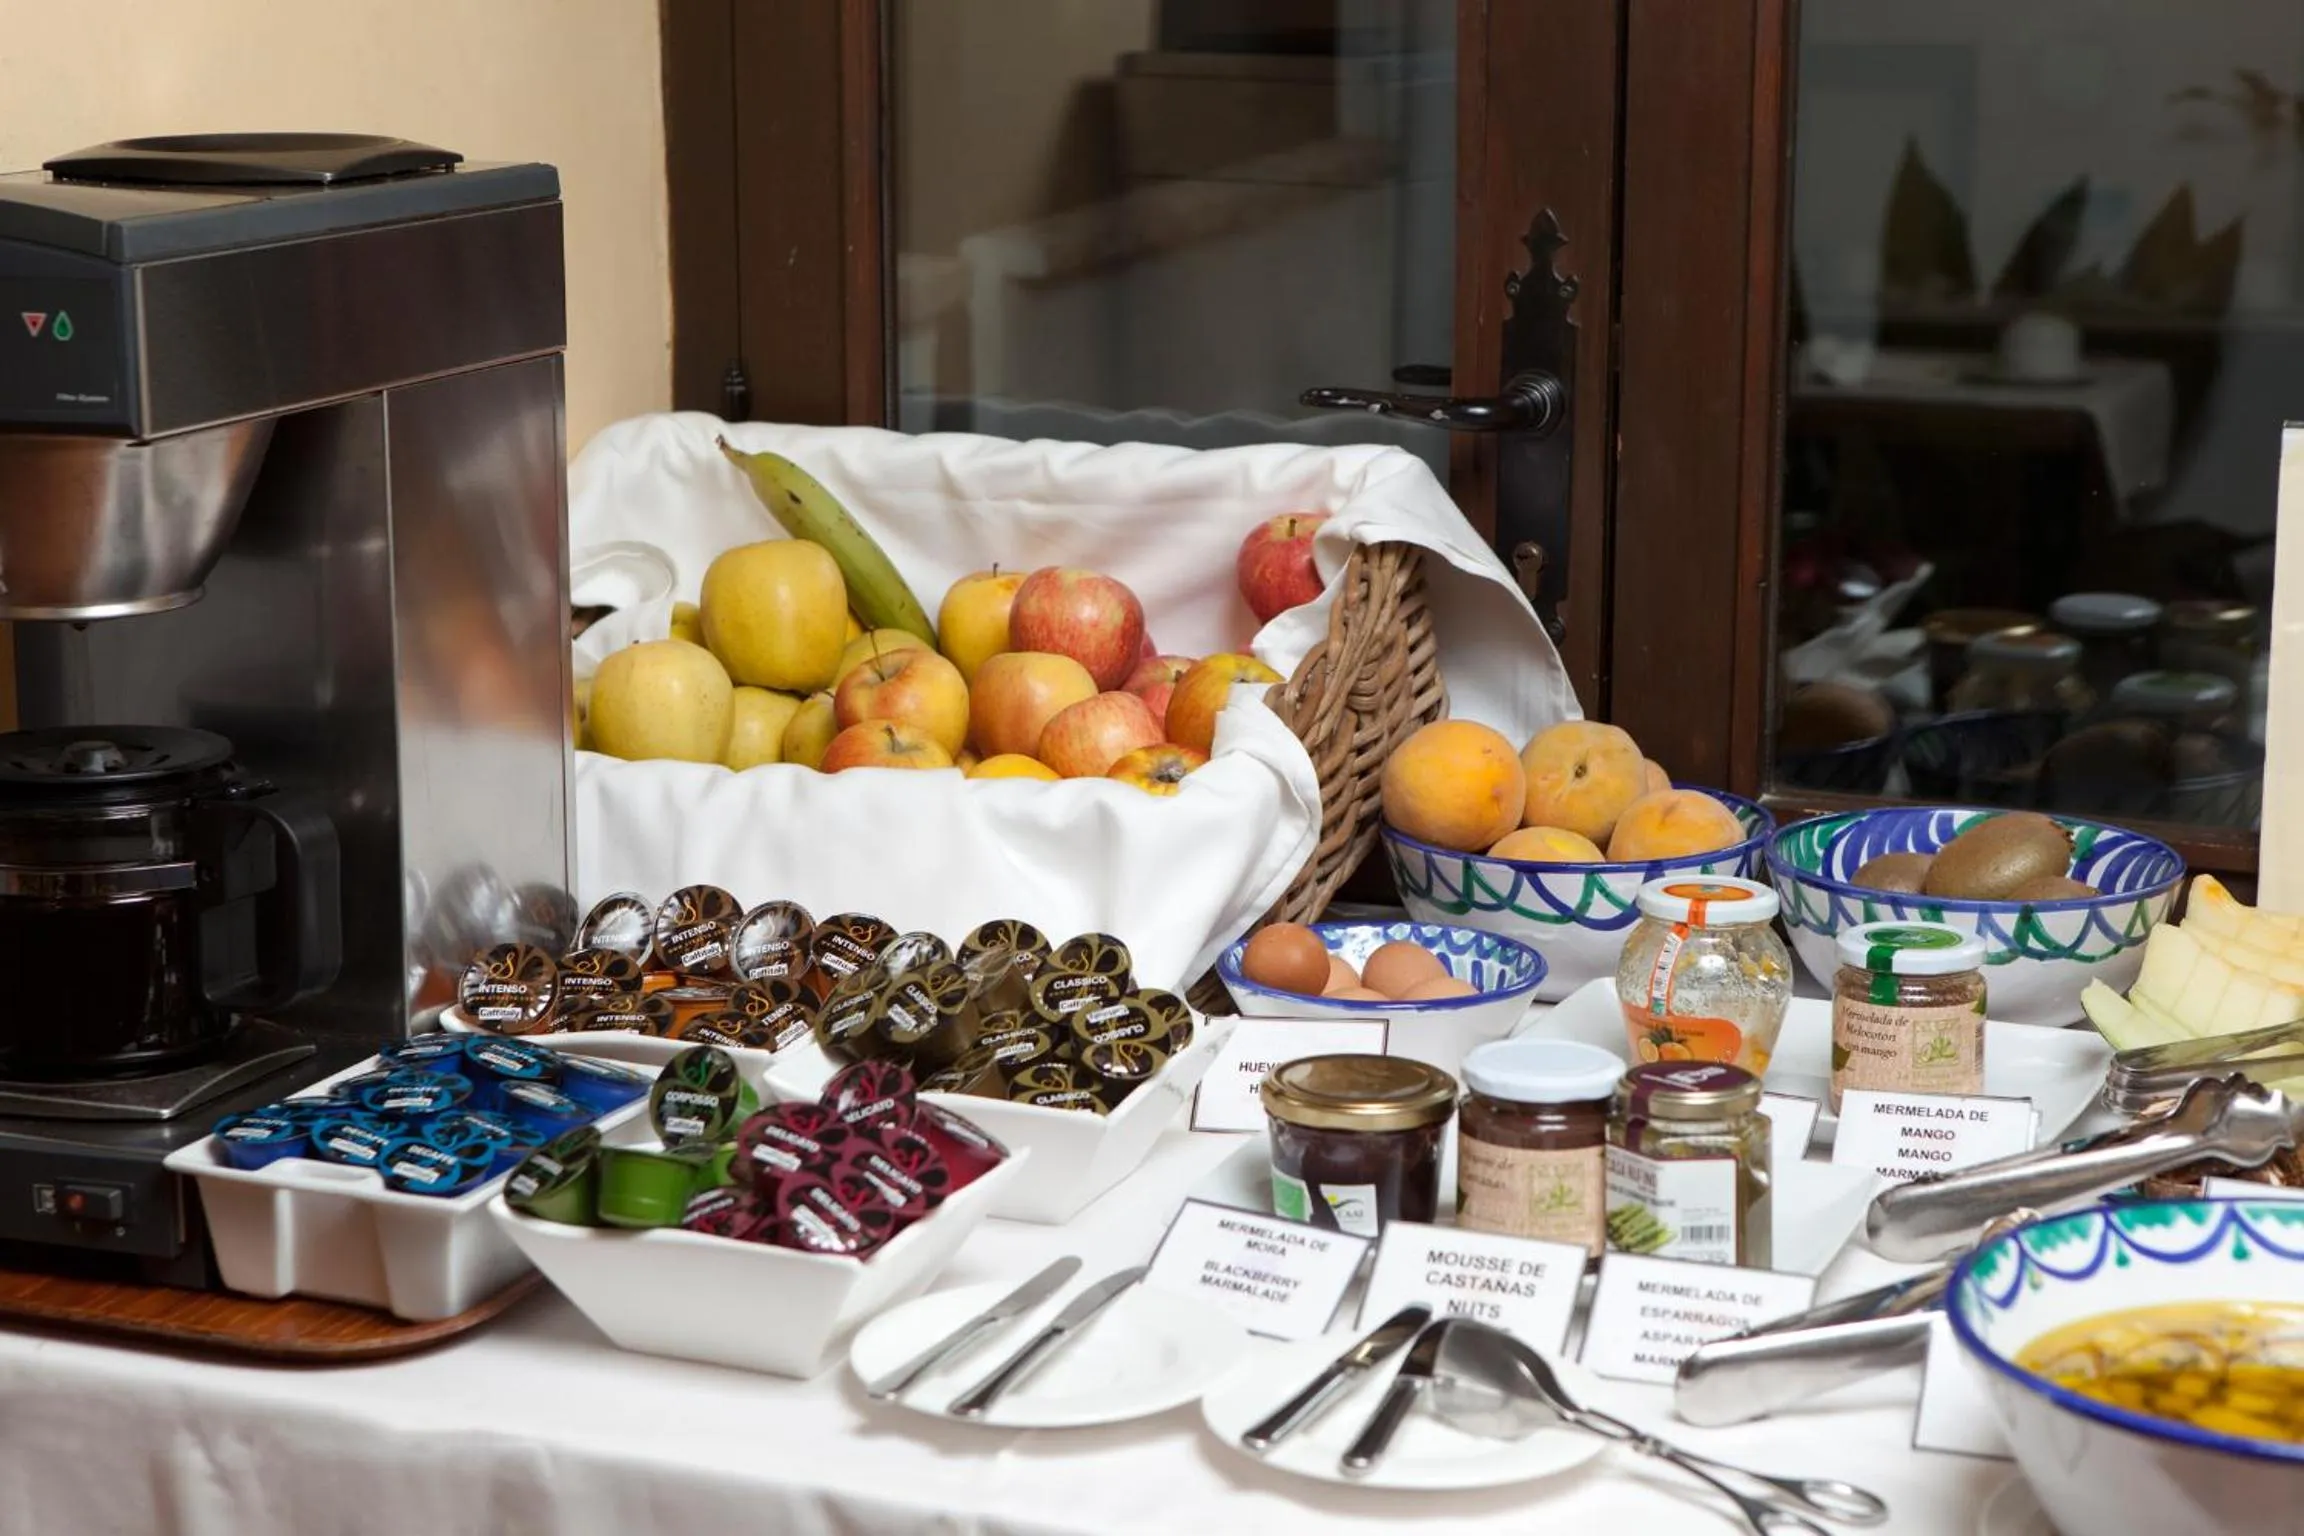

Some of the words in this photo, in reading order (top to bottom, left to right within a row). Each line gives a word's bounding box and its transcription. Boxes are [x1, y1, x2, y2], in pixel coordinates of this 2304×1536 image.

[671, 920, 717, 944] INTENSO
[745, 940, 790, 954] INTENSO
[831, 934, 876, 961] INTENSO
[478, 984, 528, 994] INTENSO
[564, 976, 613, 986] INTENSO
[1052, 975, 1108, 990] CLASSICO
[596, 1014, 647, 1023] INTENSO
[761, 1003, 794, 1026] TENSO
[1894, 1014, 1909, 1027] de
[699, 1027, 745, 1048] INTENSO
[981, 1028, 1037, 1045] CLASSICO
[1093, 1024, 1145, 1044] CLASSICO
[1860, 1046, 1898, 1060] mango
[1239, 1061, 1277, 1073] HUEV
[1036, 1091, 1091, 1105] CLASSICO
[1873, 1103, 1965, 1121] MERMELADA
[1968, 1109, 1990, 1122] DE
[1900, 1126, 1956, 1141] MANGO
[1897, 1147, 1953, 1162] MANGO
[1217, 1218, 1306, 1248] MERMELADA
[1309, 1239, 1331, 1253] DE
[1244, 1239, 1288, 1258] MORA
[1426, 1250, 1514, 1273] MOUSSE
[1518, 1260, 1548, 1278] DE
[1203, 1259, 1303, 1290] BLACKBERRY
[1199, 1274, 1291, 1304] MARMALADE
[1425, 1270, 1537, 1299] CASTAÑAS
[1637, 1280, 1737, 1302] MERMELADA
[1742, 1293, 1763, 1306] DE
[1446, 1299, 1502, 1319] NUTS
[1639, 1305, 1751, 1327] ESPARRAGOS
